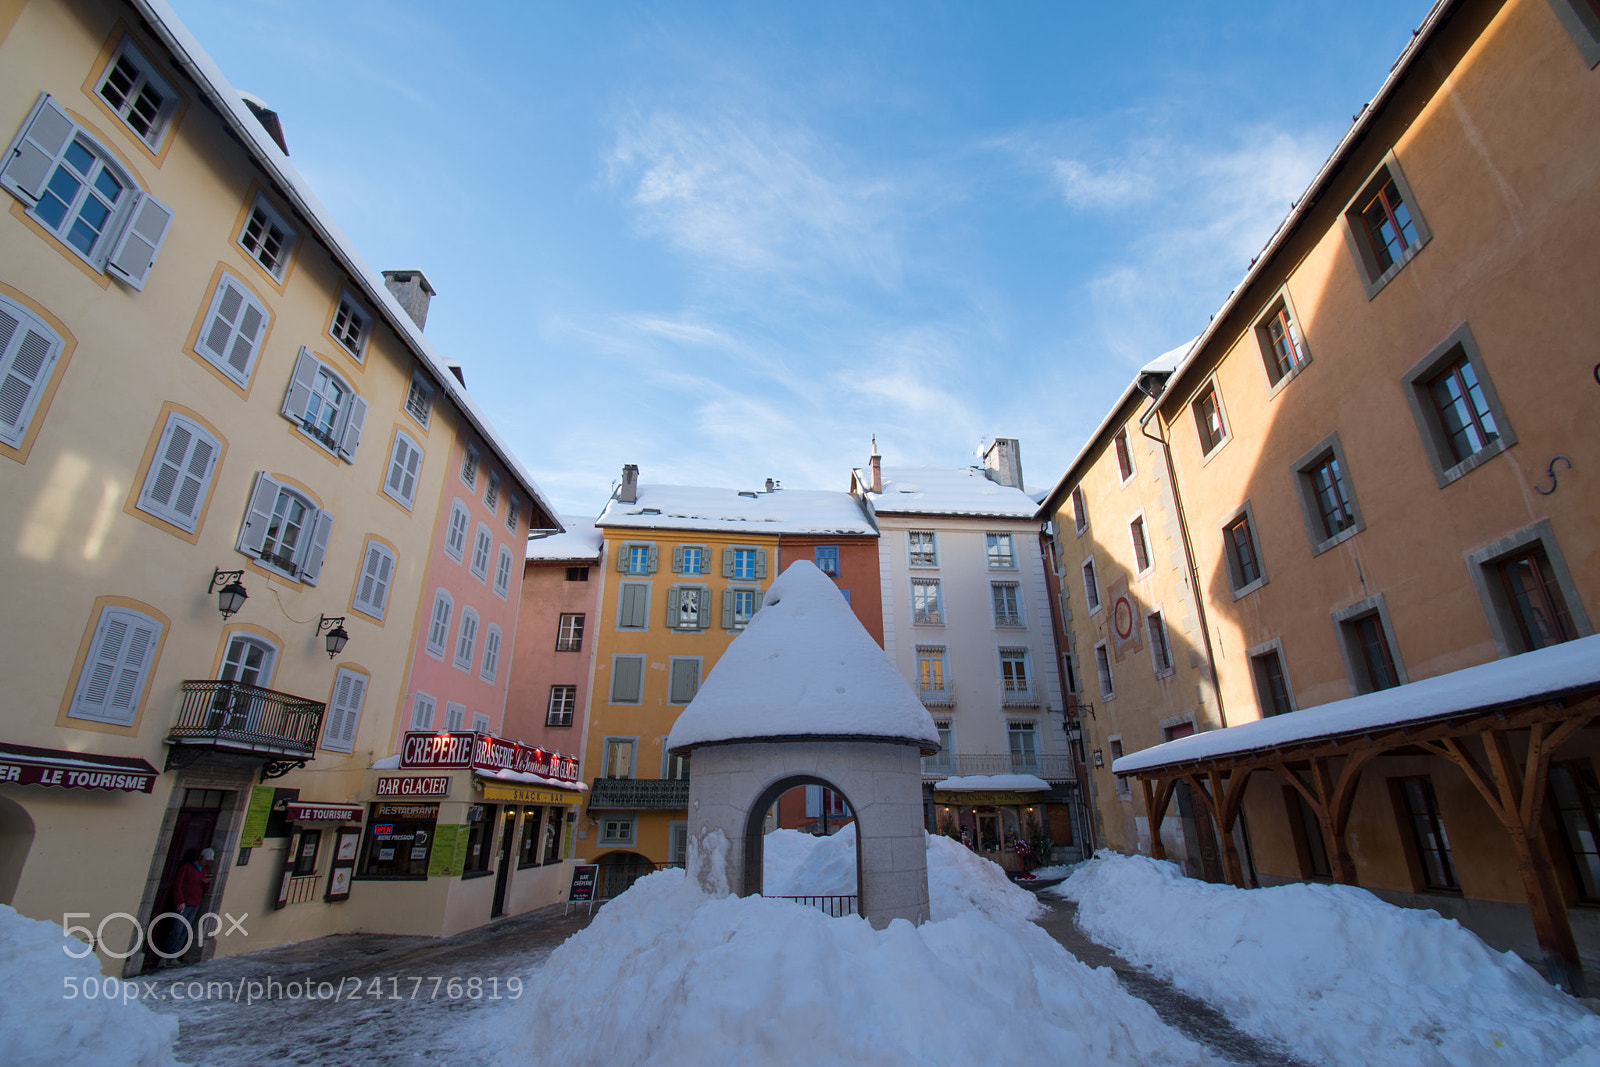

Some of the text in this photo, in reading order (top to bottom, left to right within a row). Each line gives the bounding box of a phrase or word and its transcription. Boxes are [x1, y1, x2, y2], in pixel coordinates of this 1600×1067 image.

[404, 737, 471, 764] CREPERIE
[475, 740, 515, 769] BRASSERIE
[549, 758, 560, 778] BAR
[560, 763, 579, 781] GLACIER
[40, 769, 64, 784] LE
[67, 771, 148, 790] TOURISME
[377, 777, 447, 795] BAR GLACIER
[513, 790, 541, 801] SNACK
[550, 794, 564, 802] BAR
[300, 808, 353, 820] LE TOURISME
[378, 806, 439, 815] RESTAURANT
[375, 825, 392, 834] OPEN
